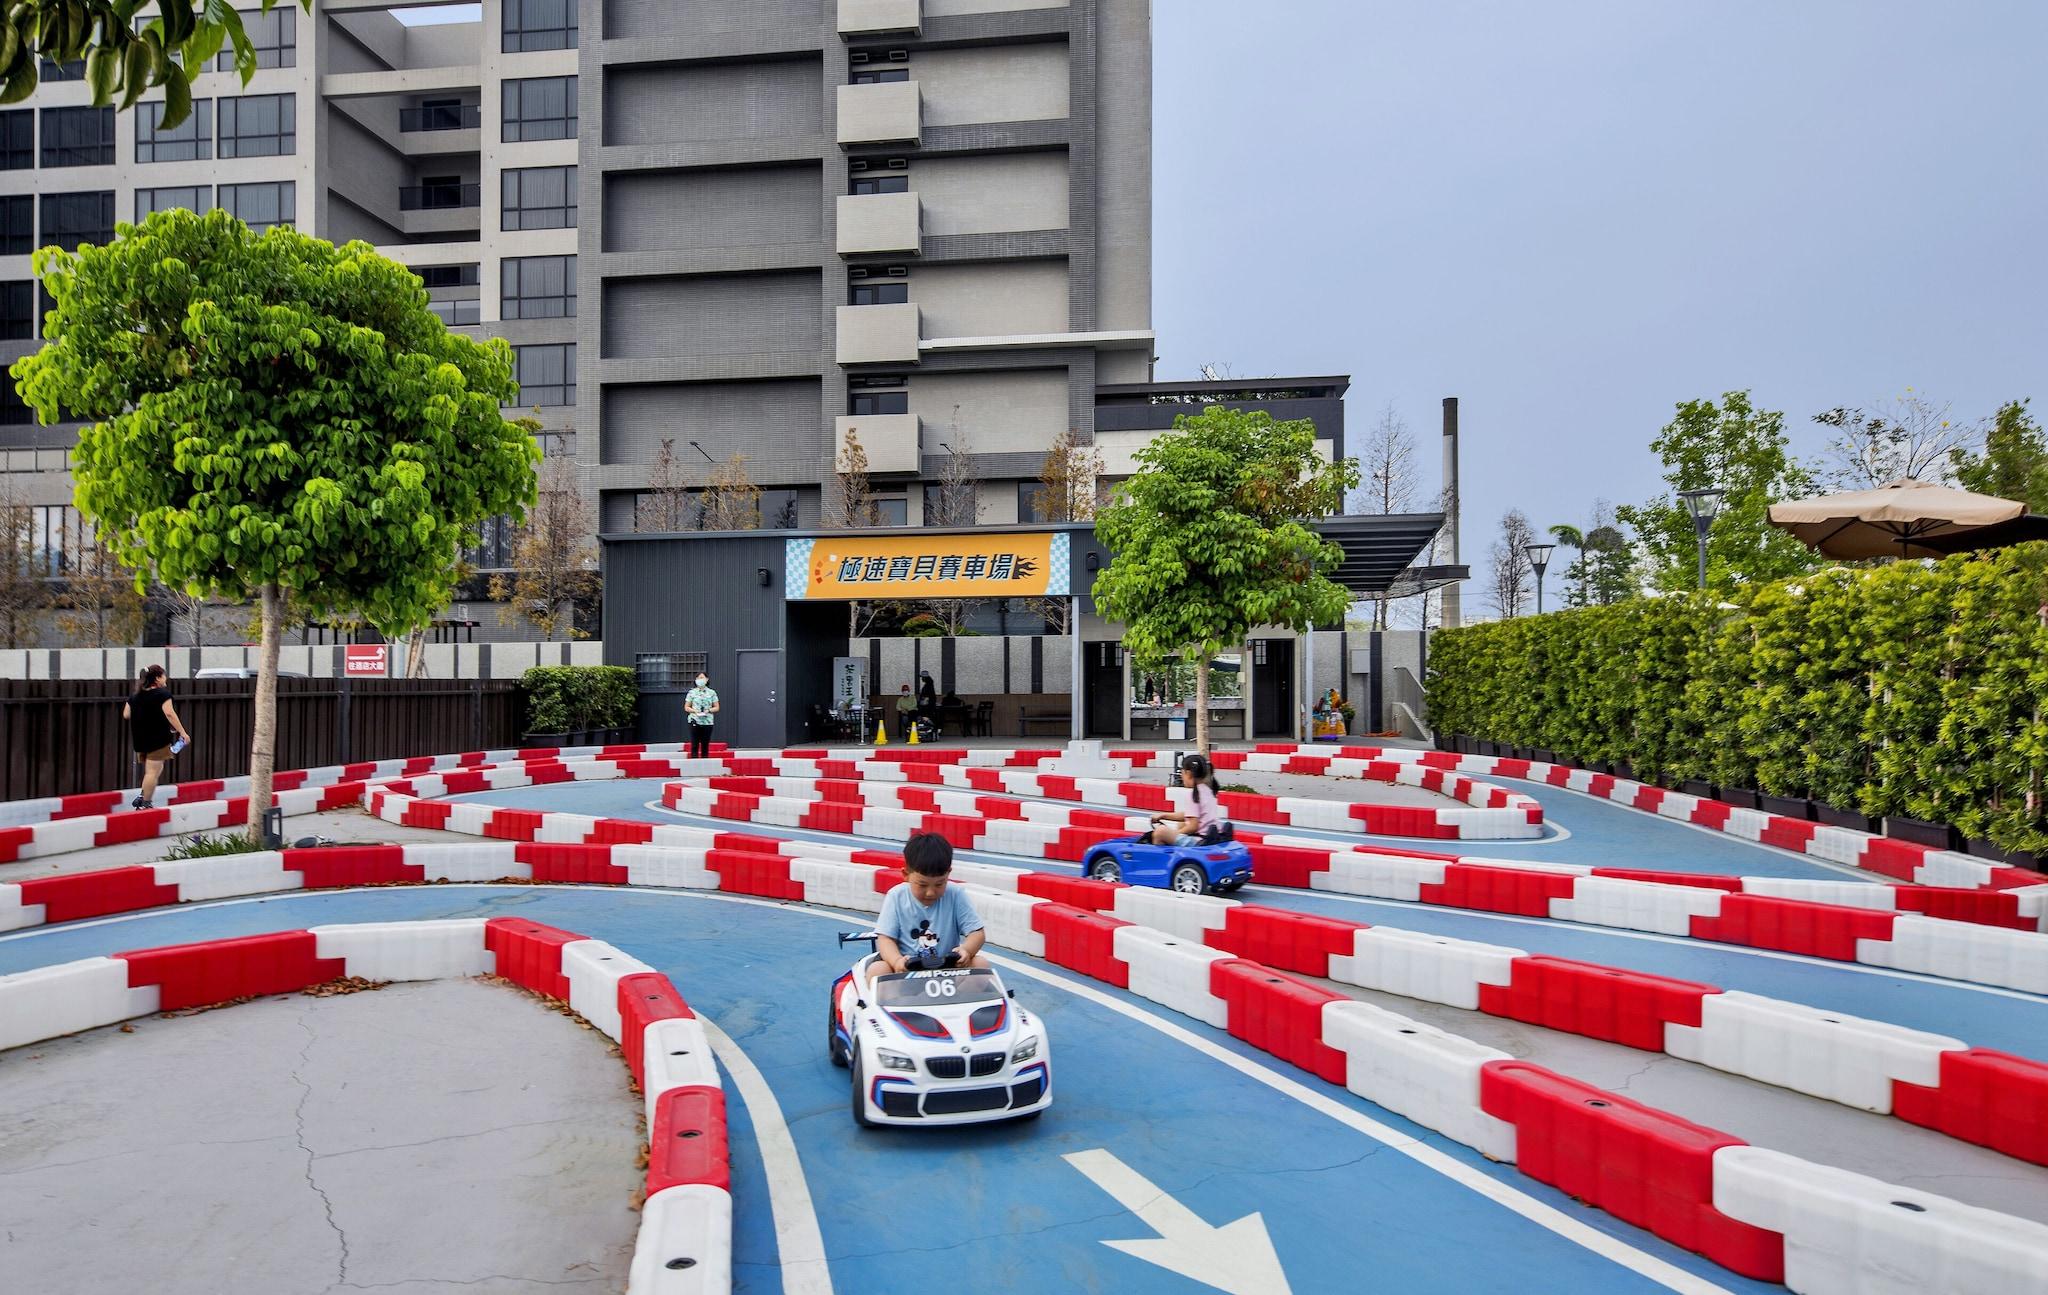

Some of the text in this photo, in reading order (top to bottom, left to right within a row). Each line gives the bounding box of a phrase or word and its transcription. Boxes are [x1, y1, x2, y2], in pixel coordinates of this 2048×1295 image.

[838, 554, 1014, 582] 極速寶貝賽車場
[1050, 763, 1056, 771] 2
[1111, 763, 1117, 771] 3
[925, 979, 956, 998] 06
